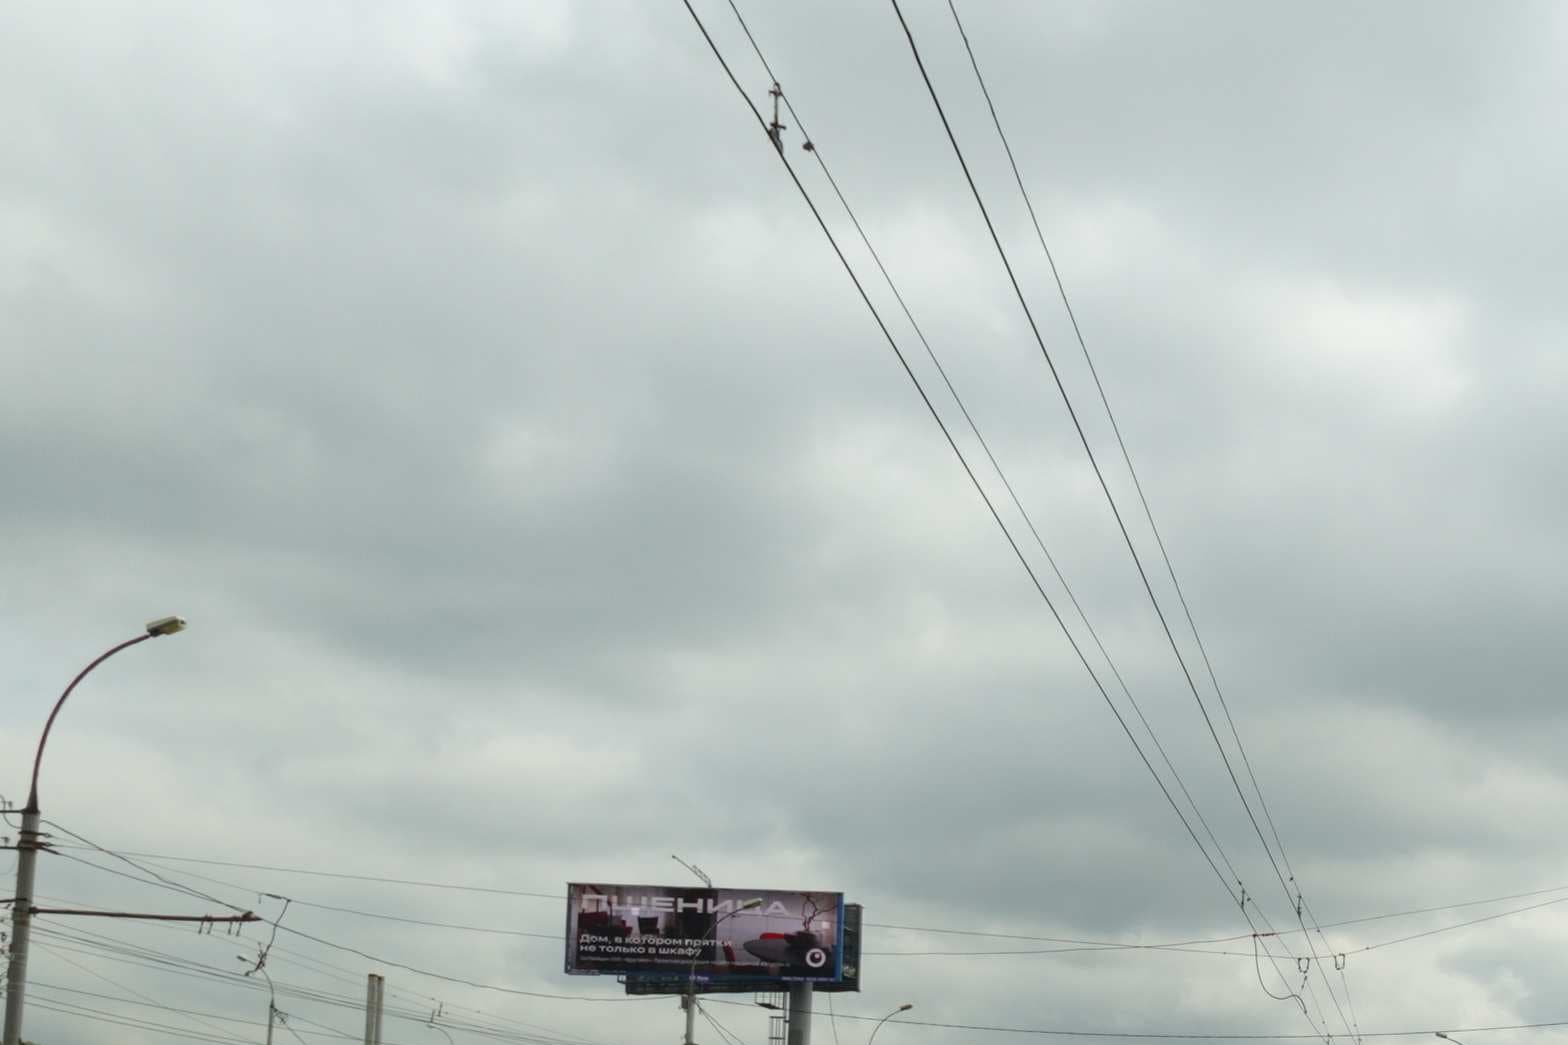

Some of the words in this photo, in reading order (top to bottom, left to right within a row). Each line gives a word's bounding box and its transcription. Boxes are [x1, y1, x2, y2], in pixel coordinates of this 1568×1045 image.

[579, 933, 612, 945] Дом,
[624, 936, 683, 947] котором
[598, 945, 645, 954] только
[647, 946, 656, 954] в
[659, 946, 702, 958] шкафу
